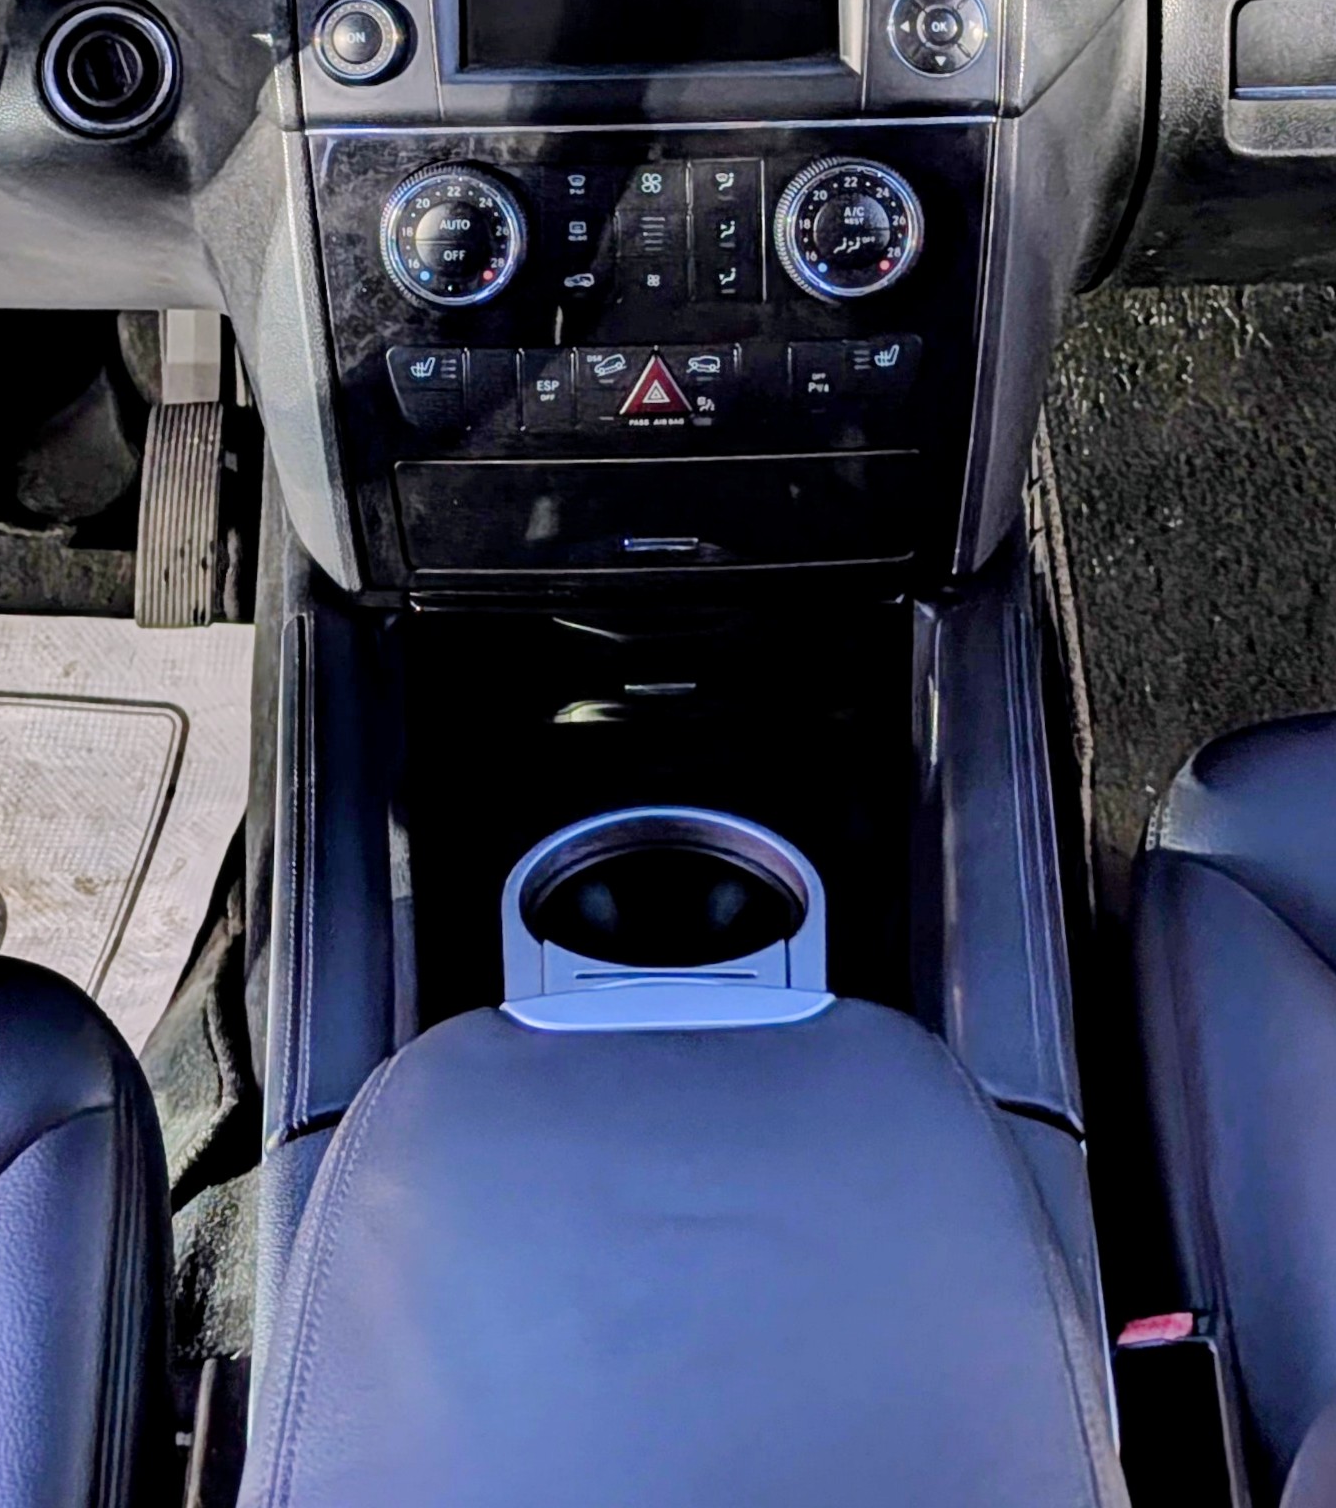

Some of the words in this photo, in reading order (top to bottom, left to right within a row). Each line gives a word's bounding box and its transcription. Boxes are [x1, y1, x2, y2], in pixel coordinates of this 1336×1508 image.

[931, 21, 948, 33] OK
[346, 30, 366, 44] ON
[844, 176, 858, 188] 22
[447, 185, 461, 197] 22
[812, 190, 828, 201] 20
[876, 187, 890, 198] 24
[415, 198, 430, 208] 20
[478, 197, 493, 208] 24
[843, 206, 865, 217] A/C
[439, 218, 471, 230] AUTO
[799, 218, 811, 230] 18
[892, 215, 906, 226] 26
[401, 227, 414, 237] 18
[495, 226, 509, 236] 26
[443, 249, 466, 262] OFF
[805, 250, 818, 261] 16
[887, 247, 901, 258] 28
[407, 258, 420, 269] 16
[490, 258, 505, 269] 28
[536, 380, 559, 392] ESP
[540, 393, 556, 402] OFF
